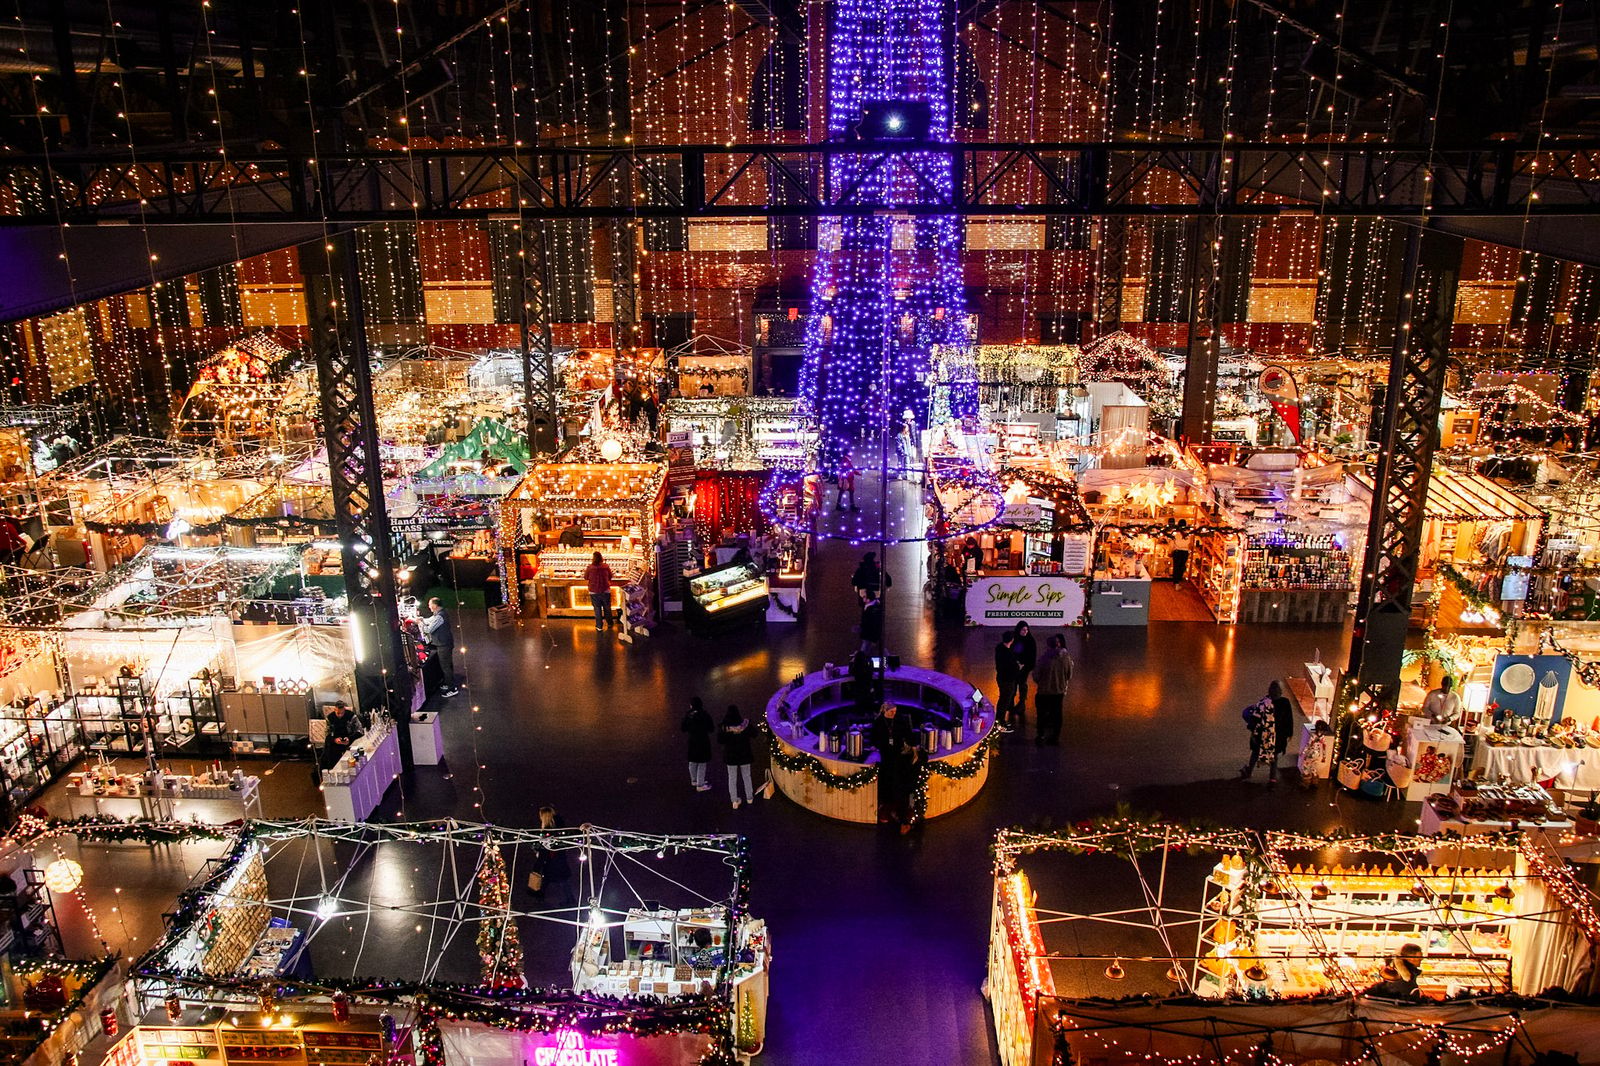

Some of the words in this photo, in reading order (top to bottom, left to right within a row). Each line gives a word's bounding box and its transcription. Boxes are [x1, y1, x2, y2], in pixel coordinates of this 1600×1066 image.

[418, 516, 449, 524] Blown
[985, 583, 1031, 607] Simple
[1035, 583, 1065, 607] Sips
[535, 1047, 618, 1066] CHOCOLATE
